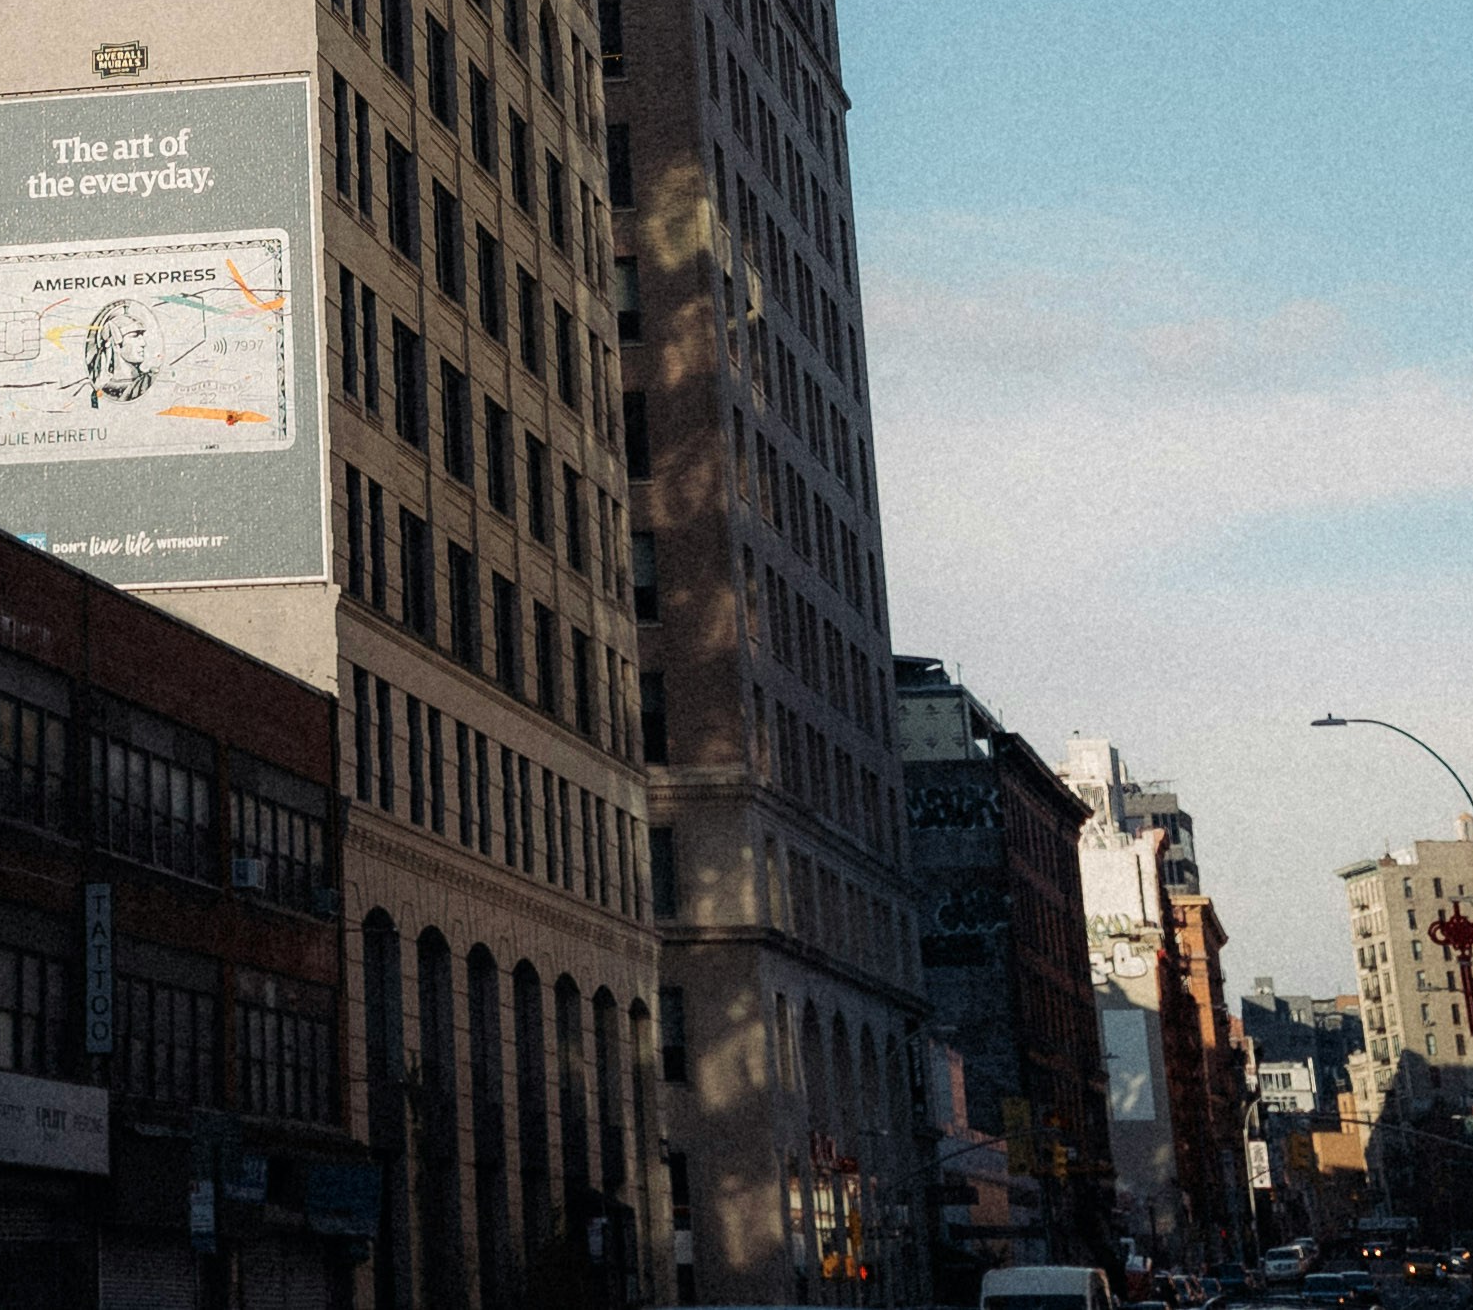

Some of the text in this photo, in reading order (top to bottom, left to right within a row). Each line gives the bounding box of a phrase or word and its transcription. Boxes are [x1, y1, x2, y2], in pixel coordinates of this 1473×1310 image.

[96, 50, 143, 61] OVERALL
[98, 58, 141, 69] MURALS
[52, 128, 192, 164] The art of
[26, 162, 214, 199] the everyday.
[32, 268, 216, 293] AMERICAN EXPRESS
[34, 427, 108, 444] MEHRETU
[52, 541, 88, 555] DON'T
[89, 535, 122, 557] live
[125, 531, 154, 557] life
[156, 536, 209, 550] WITHOUT
[91, 894, 110, 1042] TATTOO
